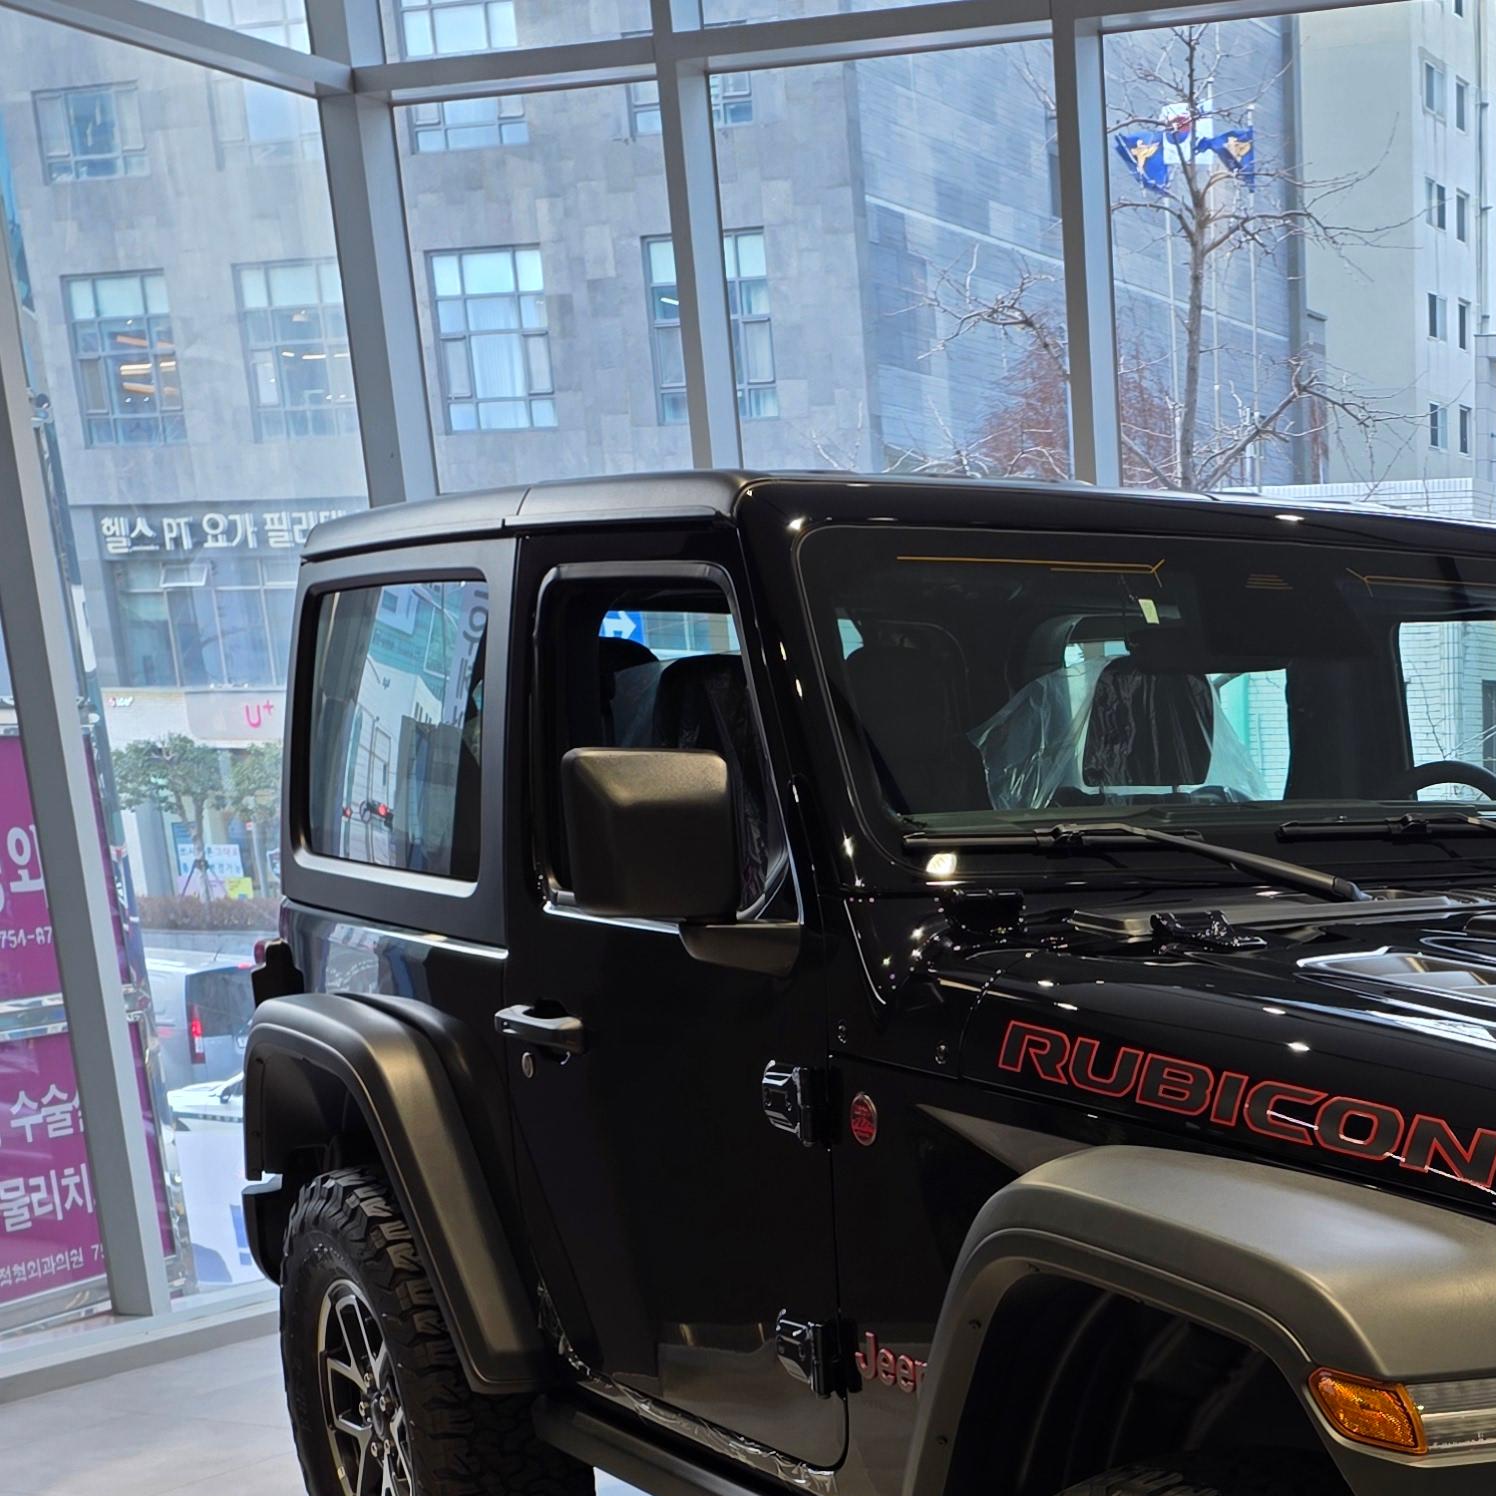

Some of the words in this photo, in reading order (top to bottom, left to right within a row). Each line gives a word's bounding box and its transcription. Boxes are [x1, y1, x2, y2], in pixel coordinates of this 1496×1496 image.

[101, 517, 159, 554] 헬스
[162, 517, 193, 550] PT
[202, 512, 257, 549] 요가
